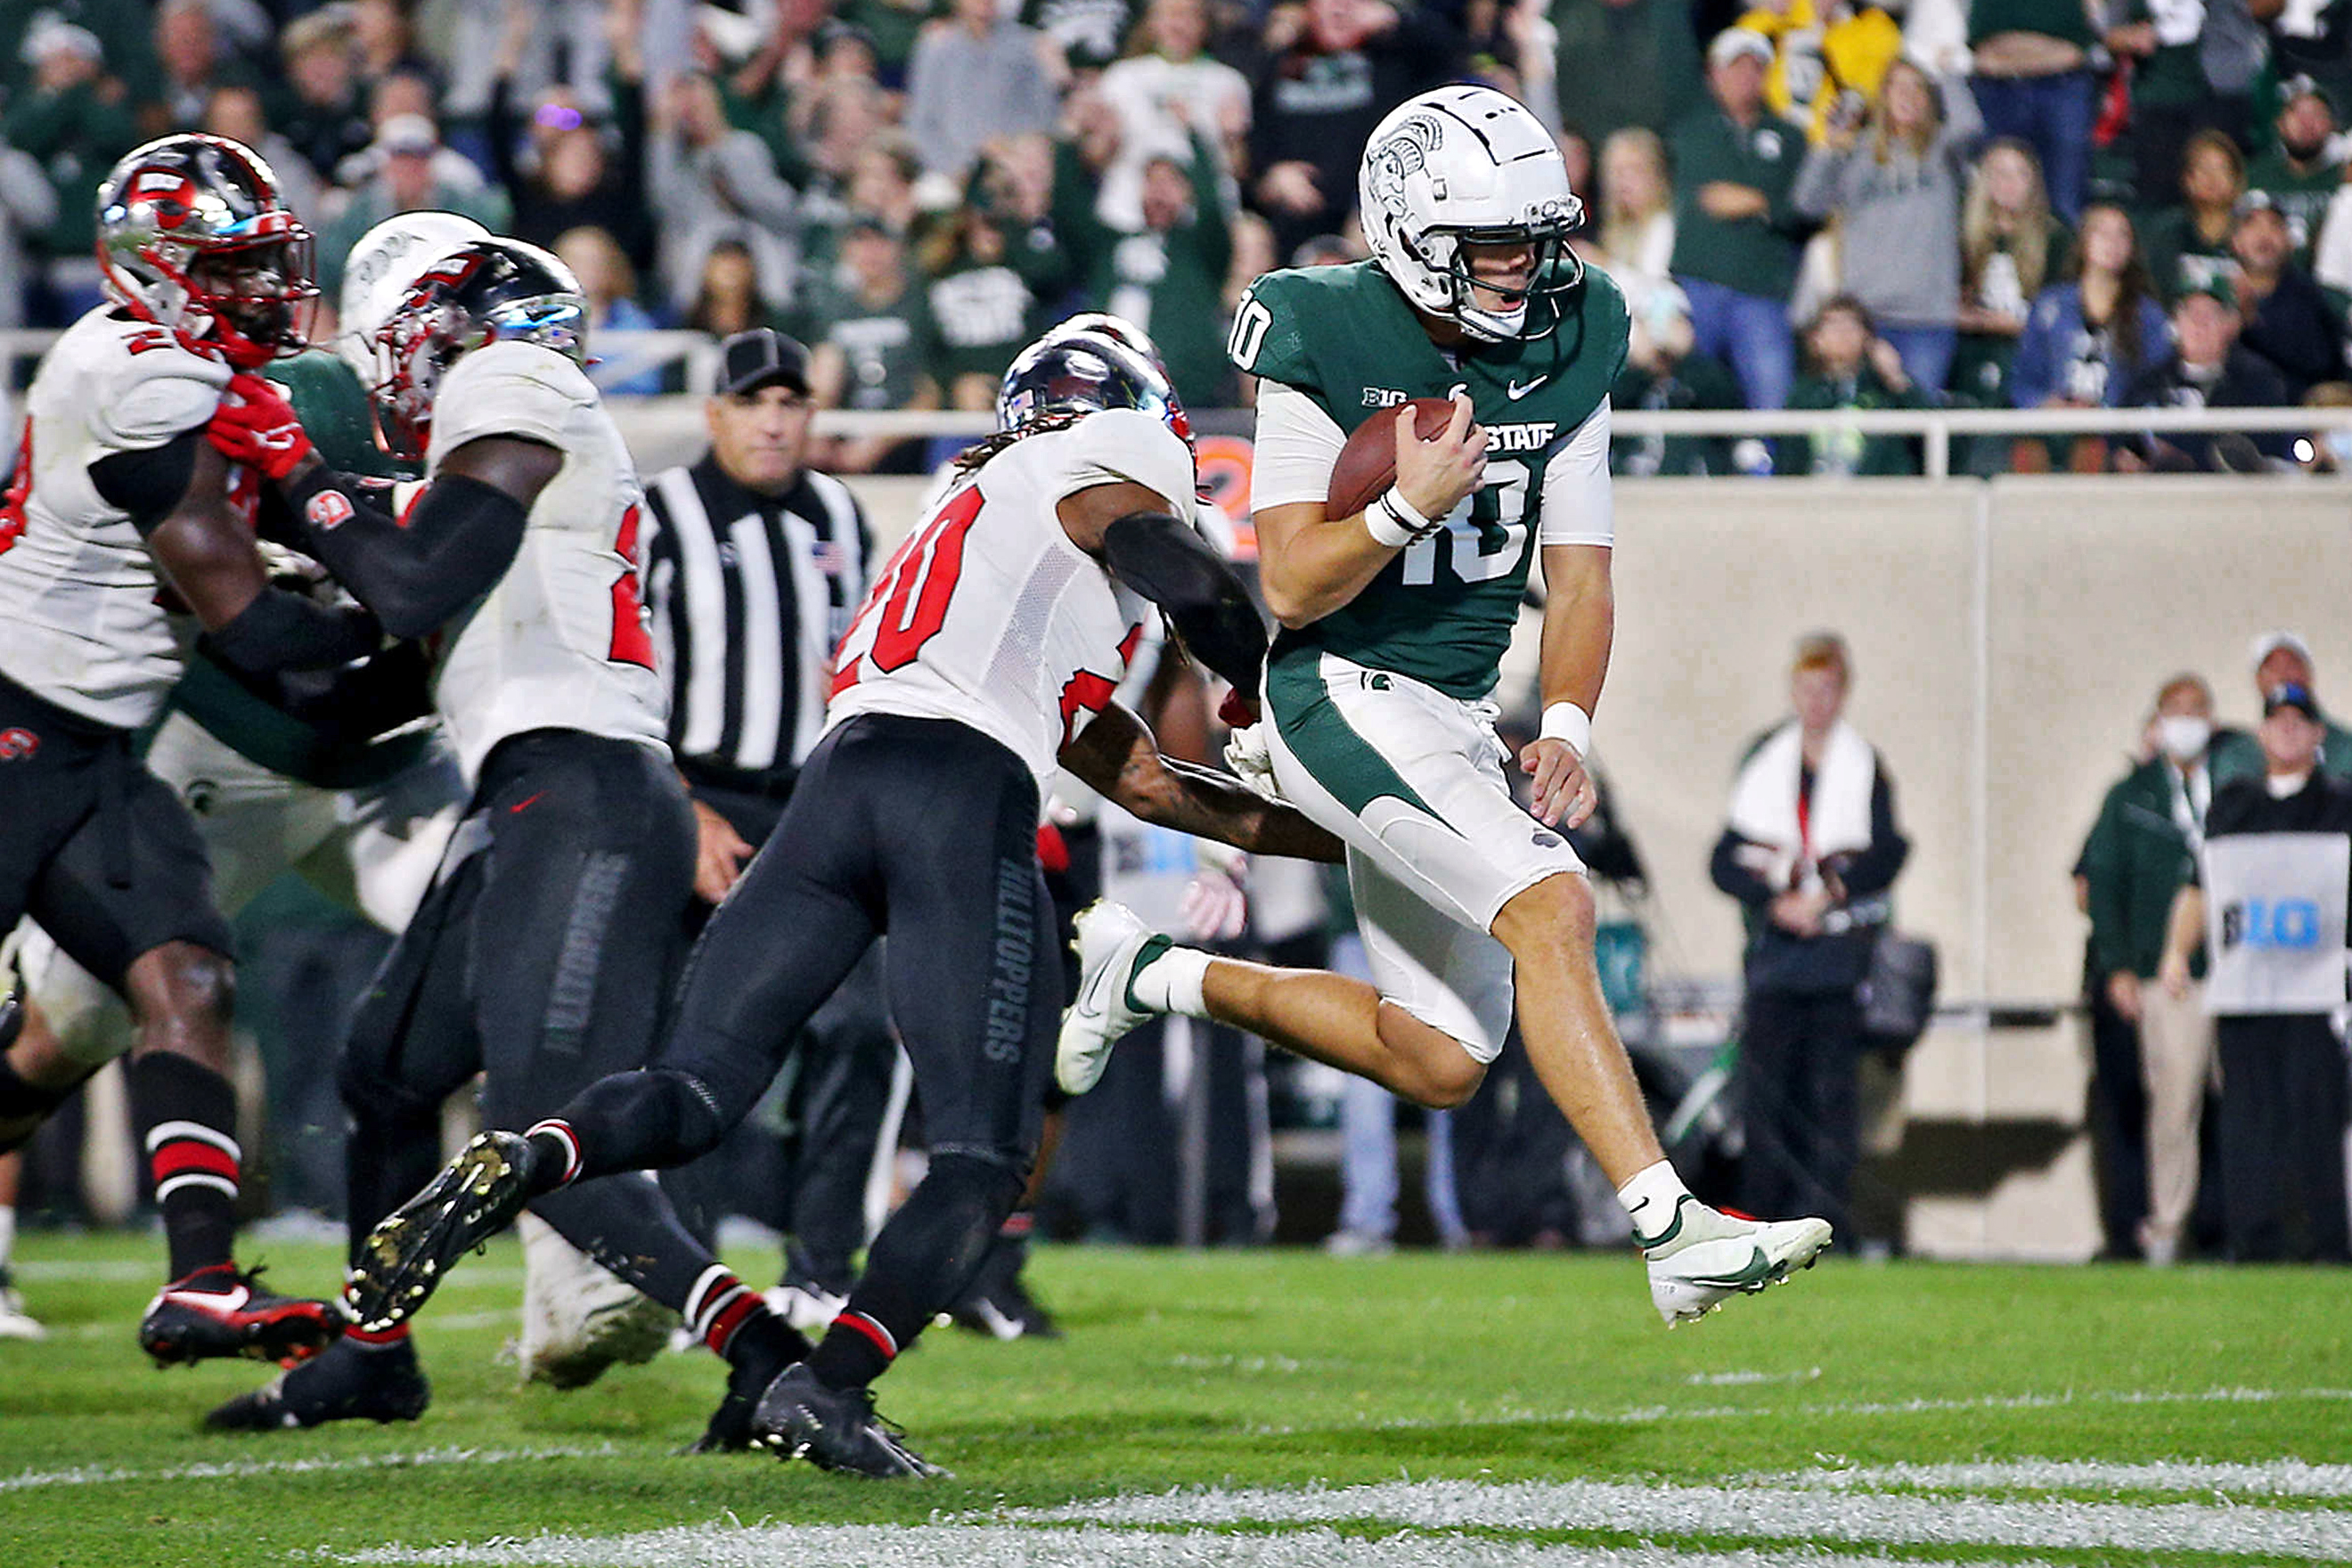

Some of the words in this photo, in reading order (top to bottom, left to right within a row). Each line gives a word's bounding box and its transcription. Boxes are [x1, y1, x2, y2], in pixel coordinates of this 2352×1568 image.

[1228, 288, 1274, 372] 10
[1486, 422, 1557, 453] STATE
[984, 857, 1033, 1063] HILLTOPPERS
